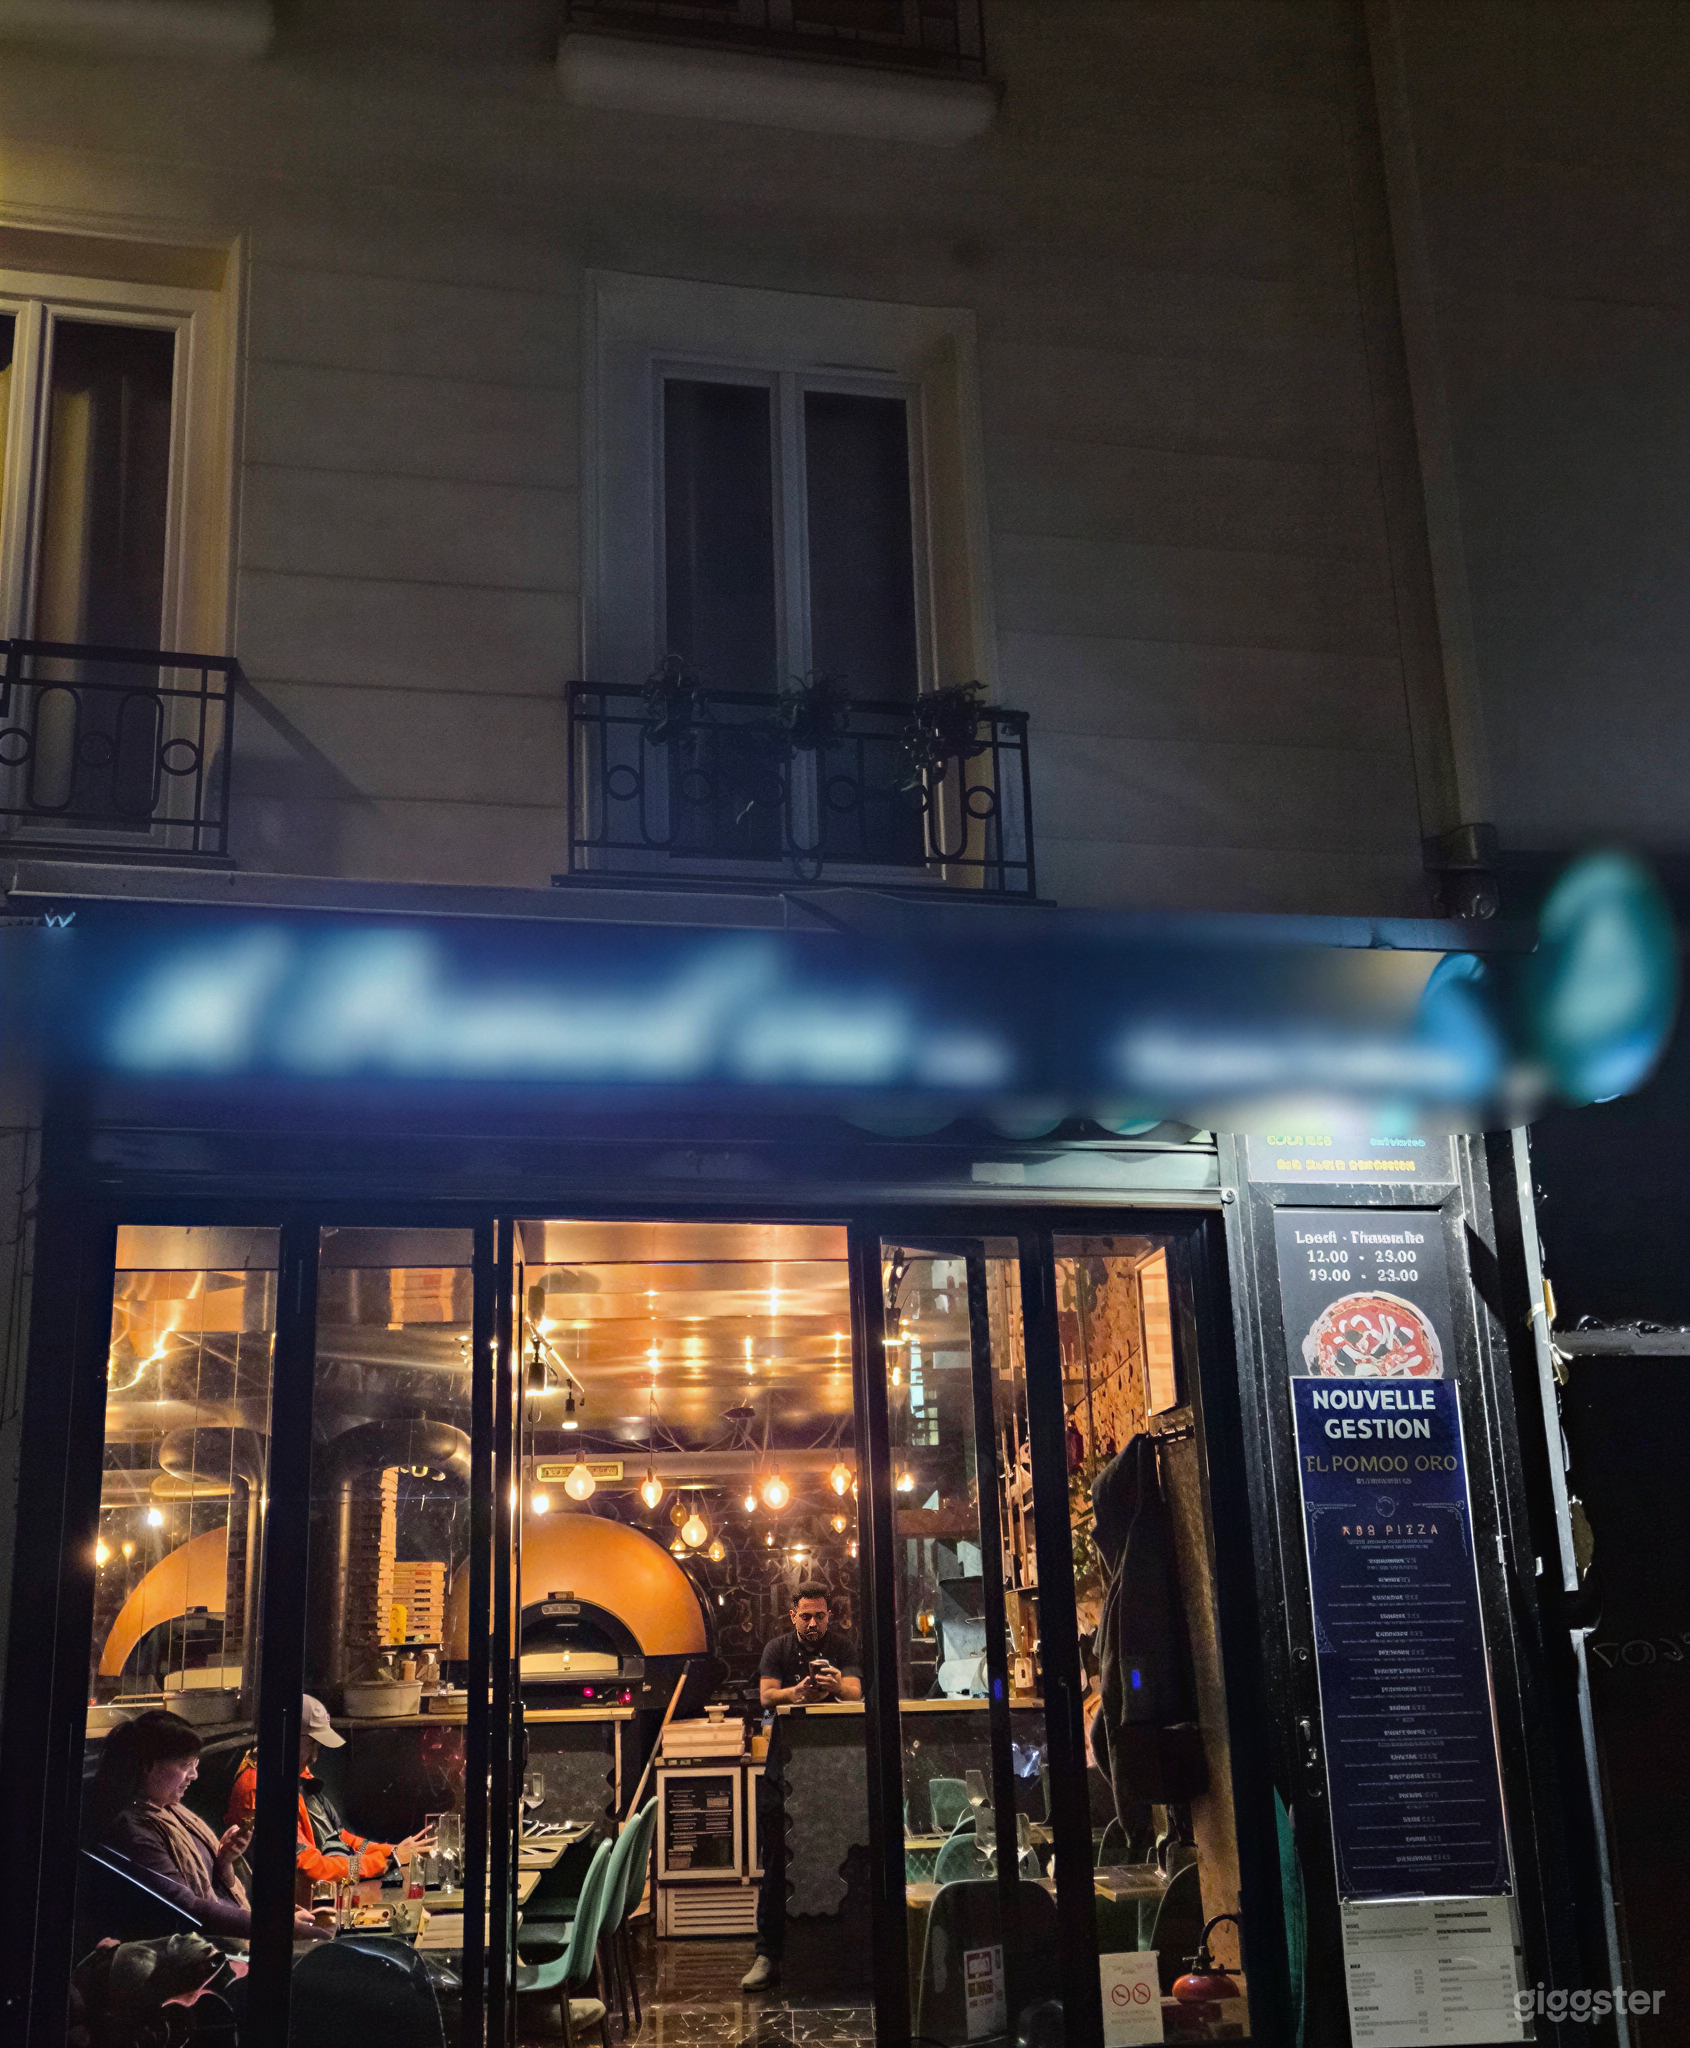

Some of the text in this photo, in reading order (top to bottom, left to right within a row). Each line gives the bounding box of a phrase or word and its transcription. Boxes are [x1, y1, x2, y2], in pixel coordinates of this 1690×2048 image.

[1307, 1249, 1349, 1264] 12.00
[1309, 1268, 1351, 1282] 19.00
[1312, 1389, 1436, 1411] NOUVELLE
[1324, 1418, 1431, 1440] GESTION
[1414, 1455, 1458, 1472] ORO
[1385, 1523, 1439, 1537] PIZZA
